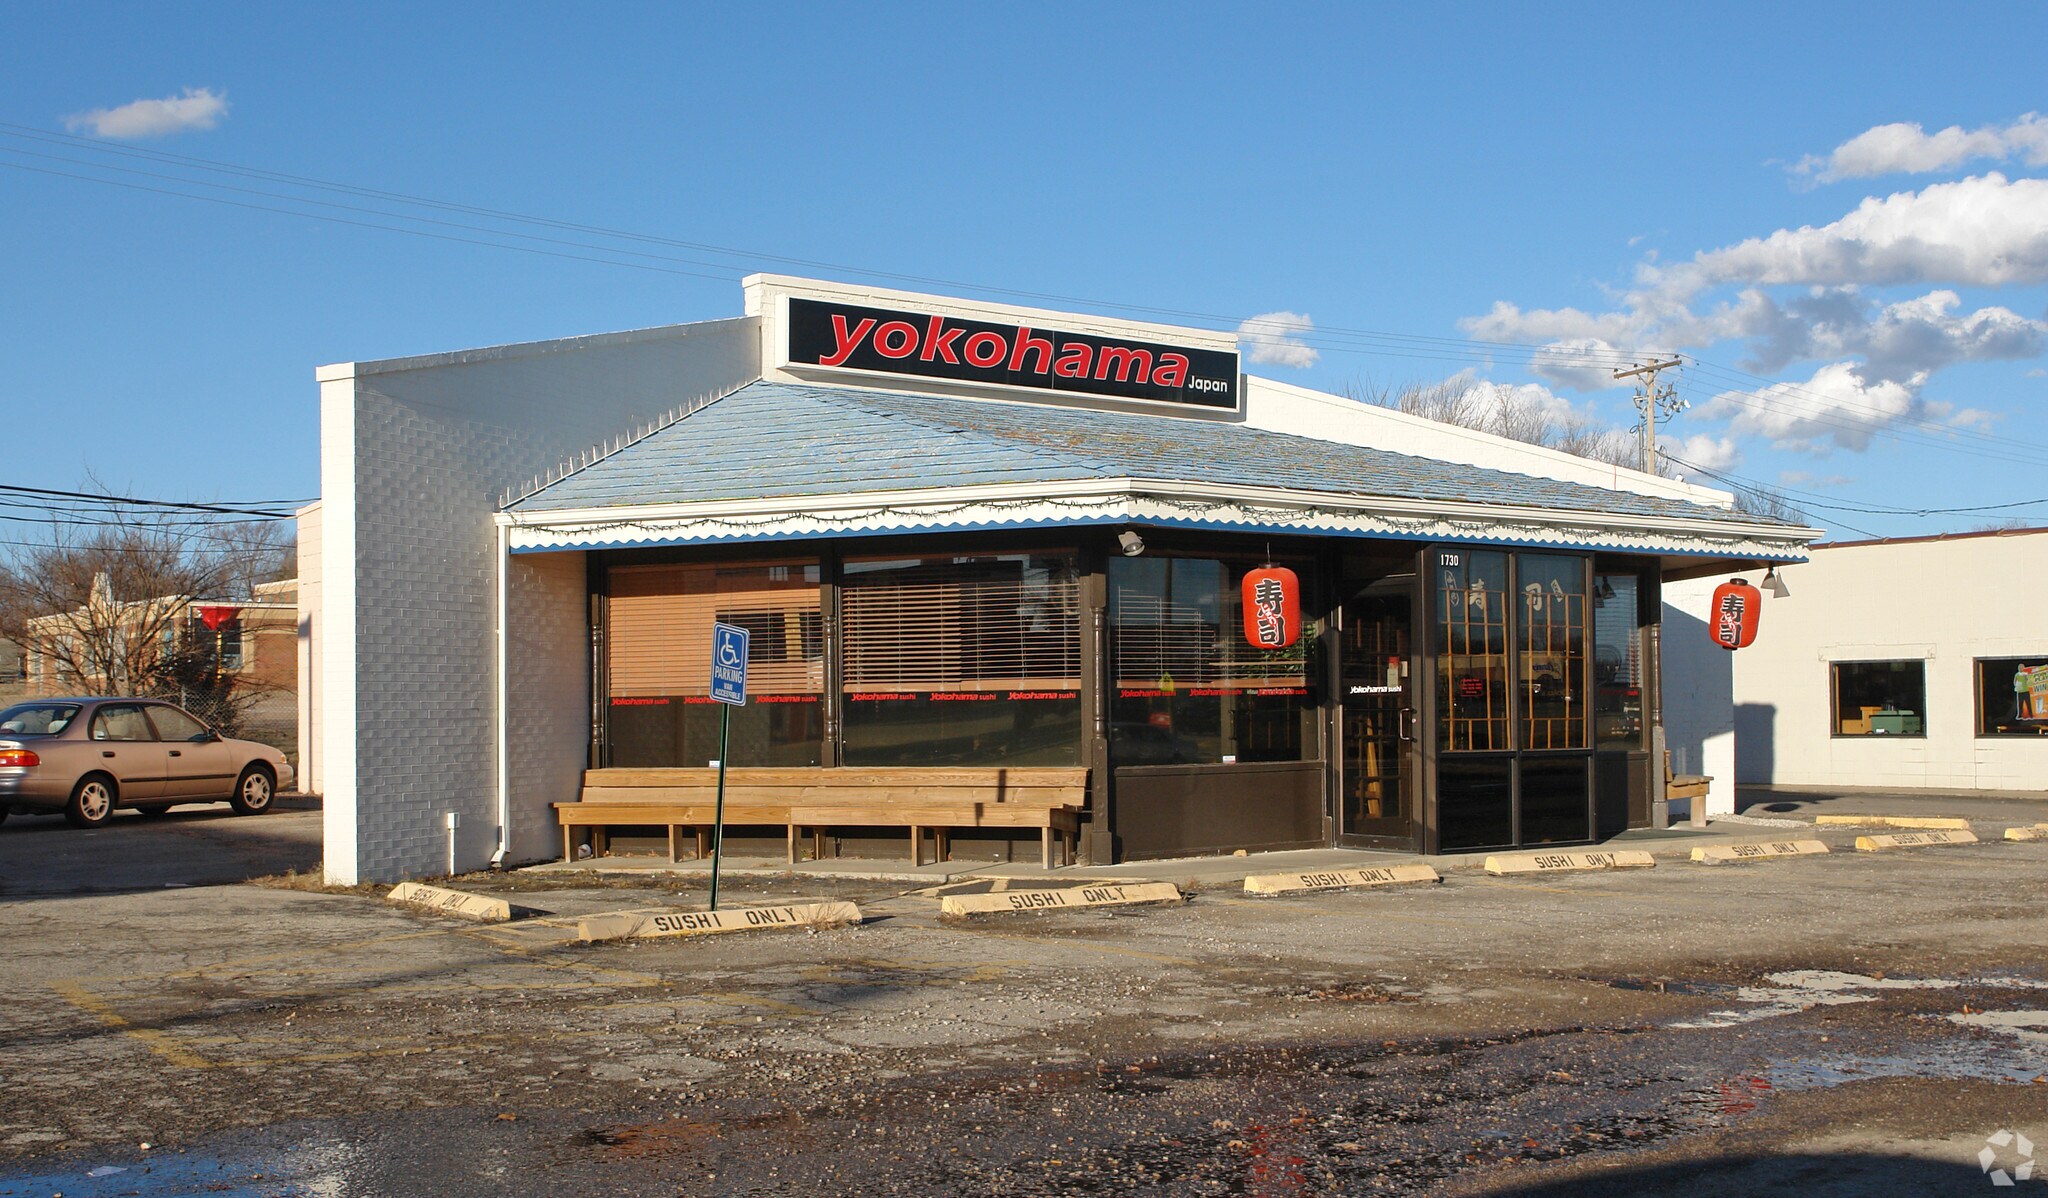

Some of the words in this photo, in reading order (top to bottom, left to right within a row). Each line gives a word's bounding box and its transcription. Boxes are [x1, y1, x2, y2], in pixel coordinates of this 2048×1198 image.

[819, 314, 1189, 388] yokohama
[1188, 375, 1228, 393] Japan
[1440, 553, 1459, 566] 1730
[714, 666, 743, 683] PARKING
[714, 688, 741, 700] ACCESSIBLE
[723, 683, 733, 691] VAN
[1891, 833, 1923, 845] SUSHI
[1926, 832, 1952, 843] ONLY
[1731, 844, 1767, 857] SUSHI
[1771, 842, 1800, 854] ONLY
[1534, 855, 1575, 869] SUSHI
[1585, 853, 1617, 866] ONLY
[1300, 873, 1348, 887] SUSHI
[1358, 868, 1396, 882] ONLY
[1008, 892, 1066, 909] SUSHI
[1082, 887, 1127, 903] ONLY
[654, 913, 722, 932] SUSHI
[745, 907, 797, 926] ONLY
